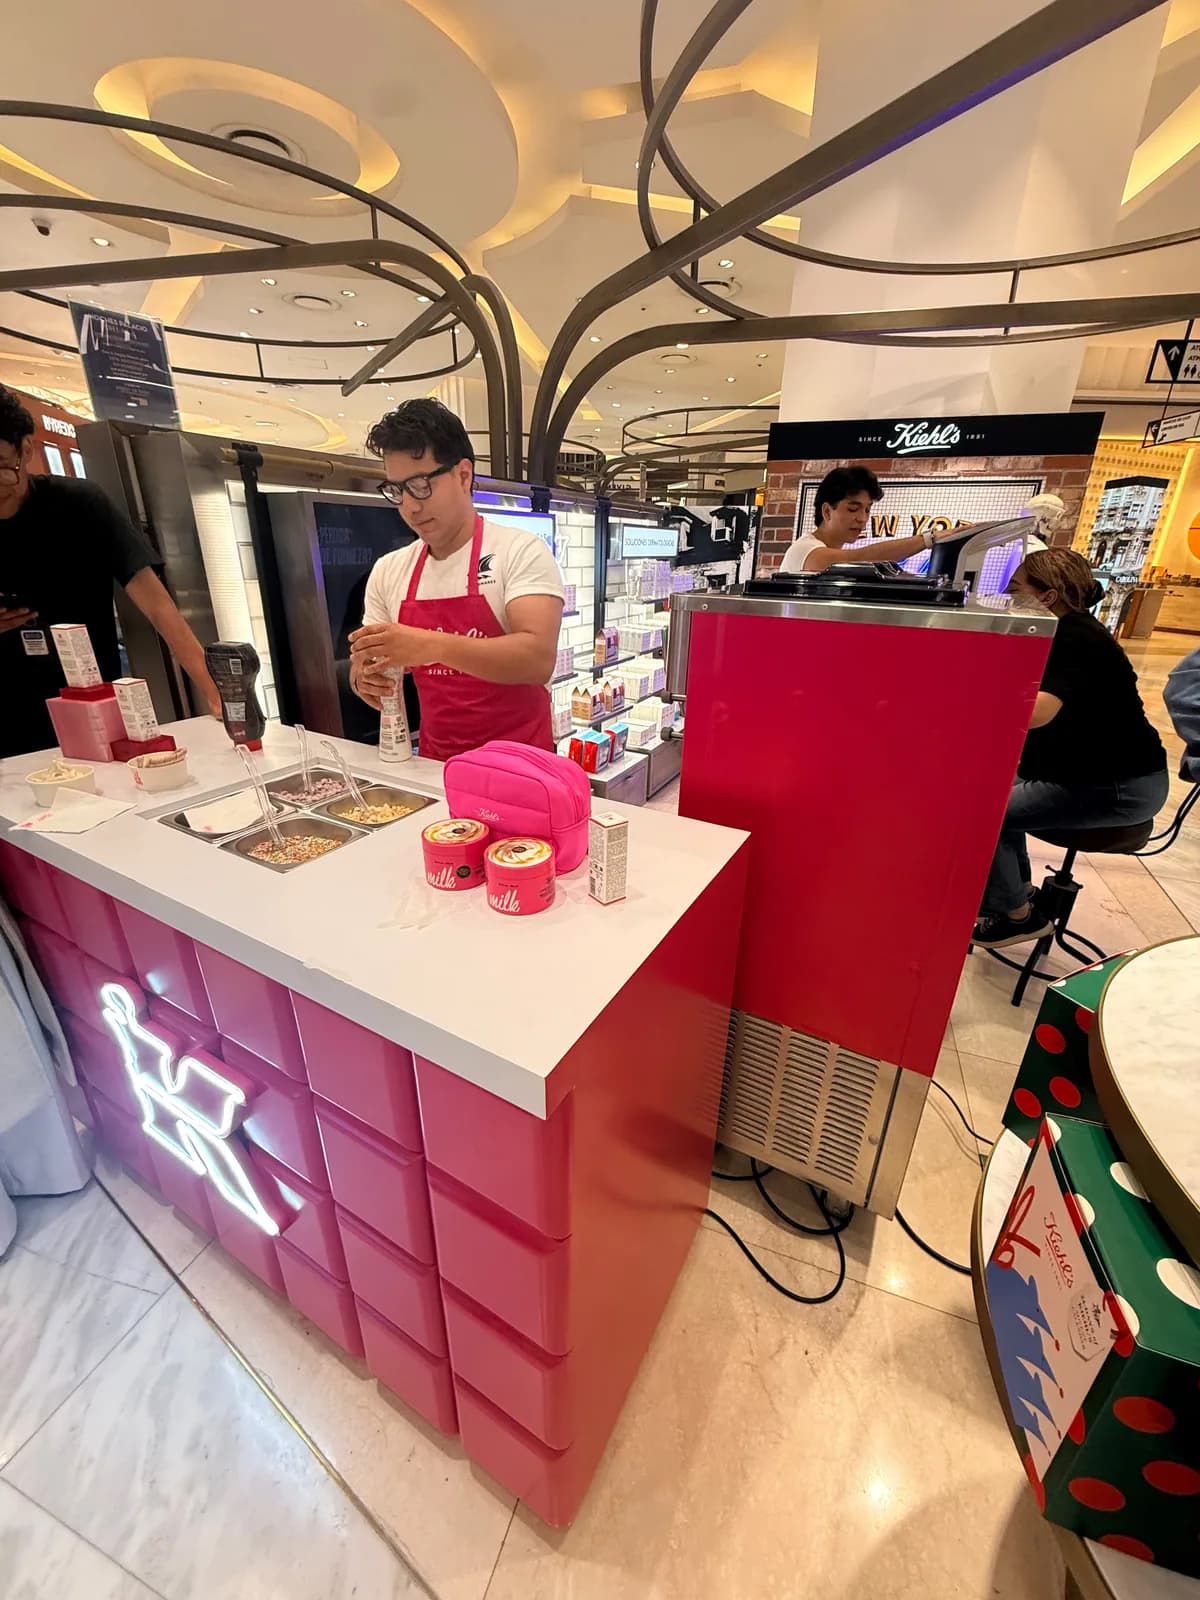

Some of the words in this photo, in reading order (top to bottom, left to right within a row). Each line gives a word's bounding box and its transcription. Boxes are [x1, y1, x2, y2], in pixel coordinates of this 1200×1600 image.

[886, 421, 961, 452] Kiehl's
[426, 866, 457, 889] milk
[489, 889, 521, 913] milk
[1043, 1211, 1073, 1289] Kiehl's
